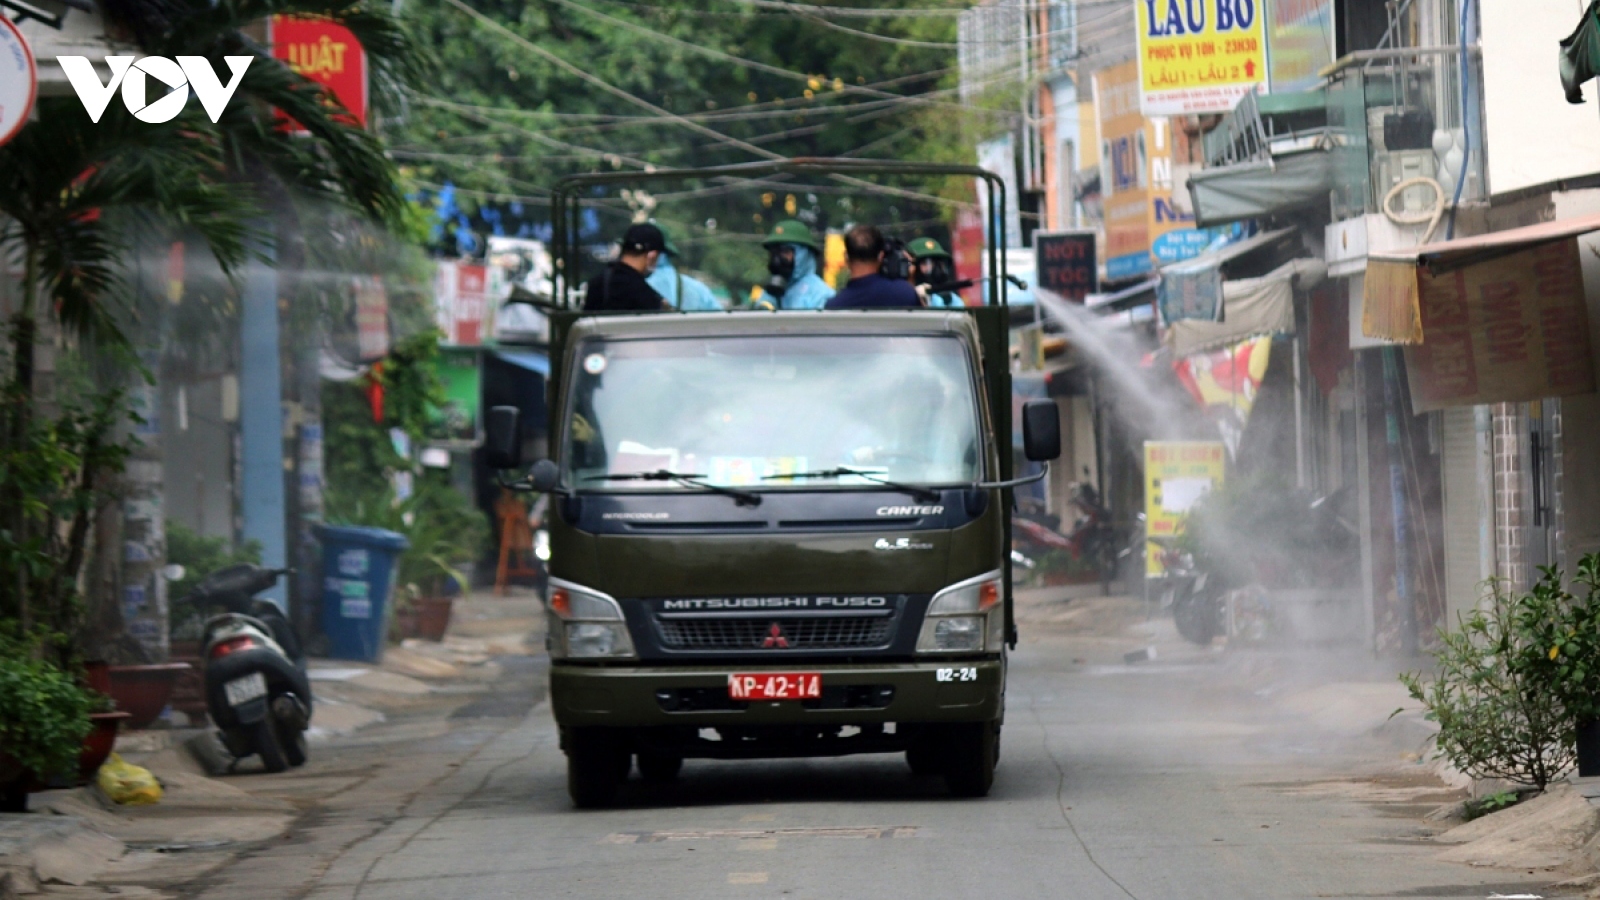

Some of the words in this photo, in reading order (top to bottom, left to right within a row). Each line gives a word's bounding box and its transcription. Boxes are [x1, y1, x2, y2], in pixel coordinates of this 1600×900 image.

[1148, 43, 1176, 62] PHỤC
[1178, 42, 1192, 60] VỤ
[1224, 37, 1257, 55] 23H30
[288, 34, 348, 80] LUẬT
[1231, 65, 1240, 79] 2
[876, 505, 945, 516] CANTER
[664, 598, 808, 609] MITSUBISHI
[815, 597, 886, 607] FUSO
[936, 668, 977, 682] 02-24
[730, 675, 821, 698] KP-42-14
